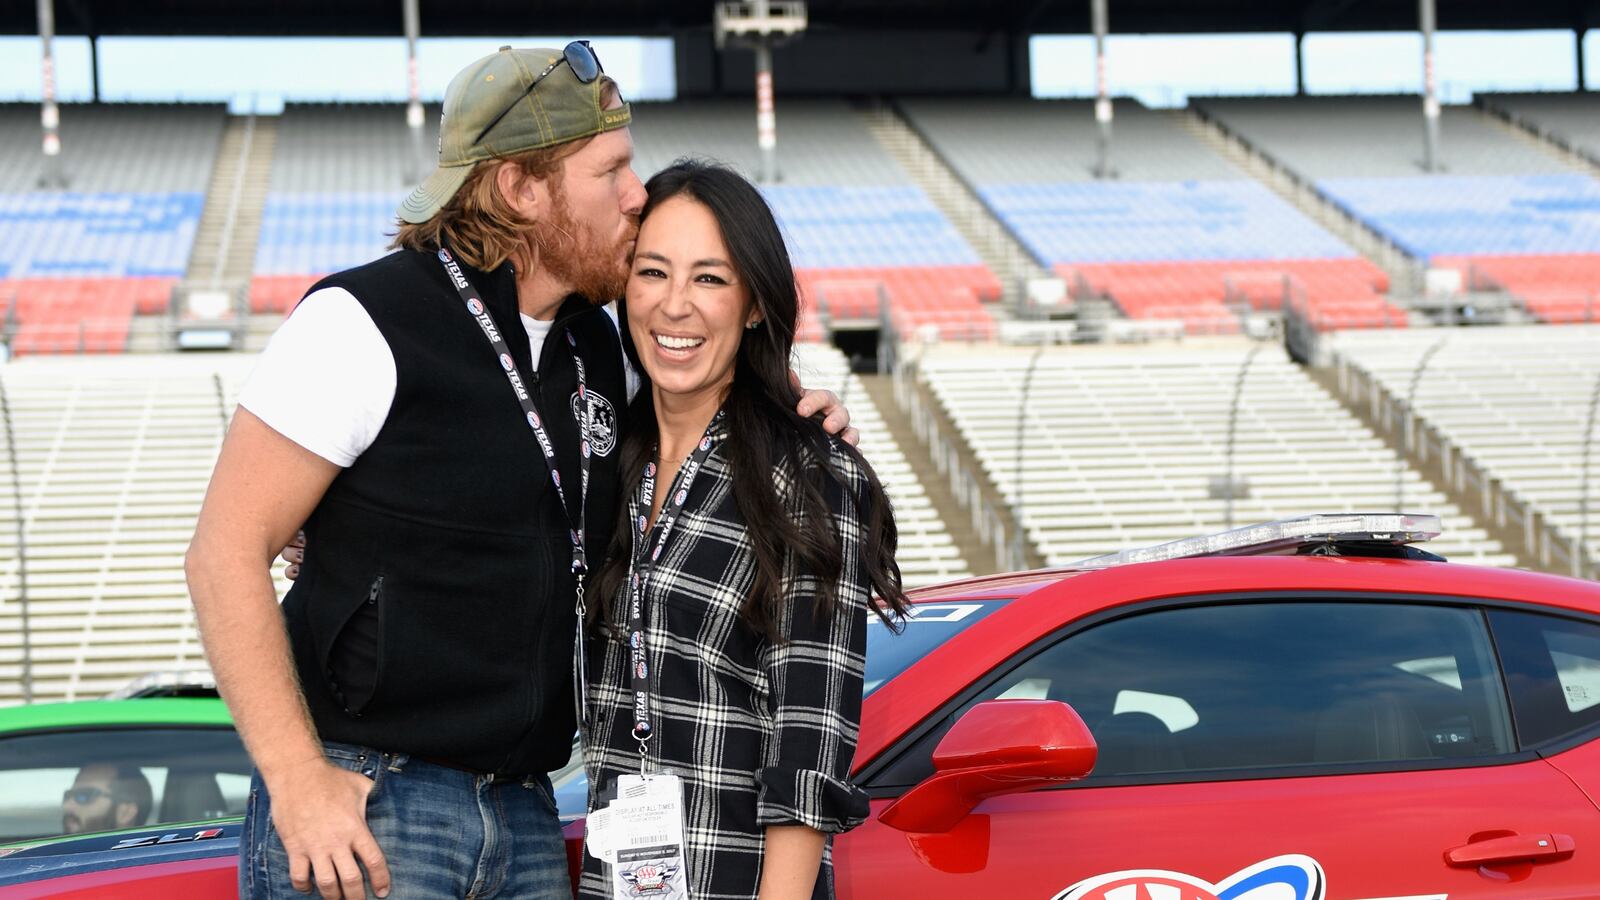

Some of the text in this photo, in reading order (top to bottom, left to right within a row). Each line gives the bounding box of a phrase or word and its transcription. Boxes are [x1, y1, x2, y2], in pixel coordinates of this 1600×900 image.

[447, 260, 469, 290] TEXAS
[478, 312, 502, 344] TEXAS
[573, 354, 586, 384] TEXAS
[507, 369, 529, 401] TEXAS
[580, 410, 591, 440] TEXAS
[535, 426, 555, 458] TEXAS
[681, 460, 698, 490] TEXAS
[643, 477, 655, 507] TEXAS
[659, 516, 674, 545] TEXAS
[633, 589, 641, 619] TEXAS
[636, 691, 645, 721] TEXAS
[111, 828, 224, 850] ZL1
